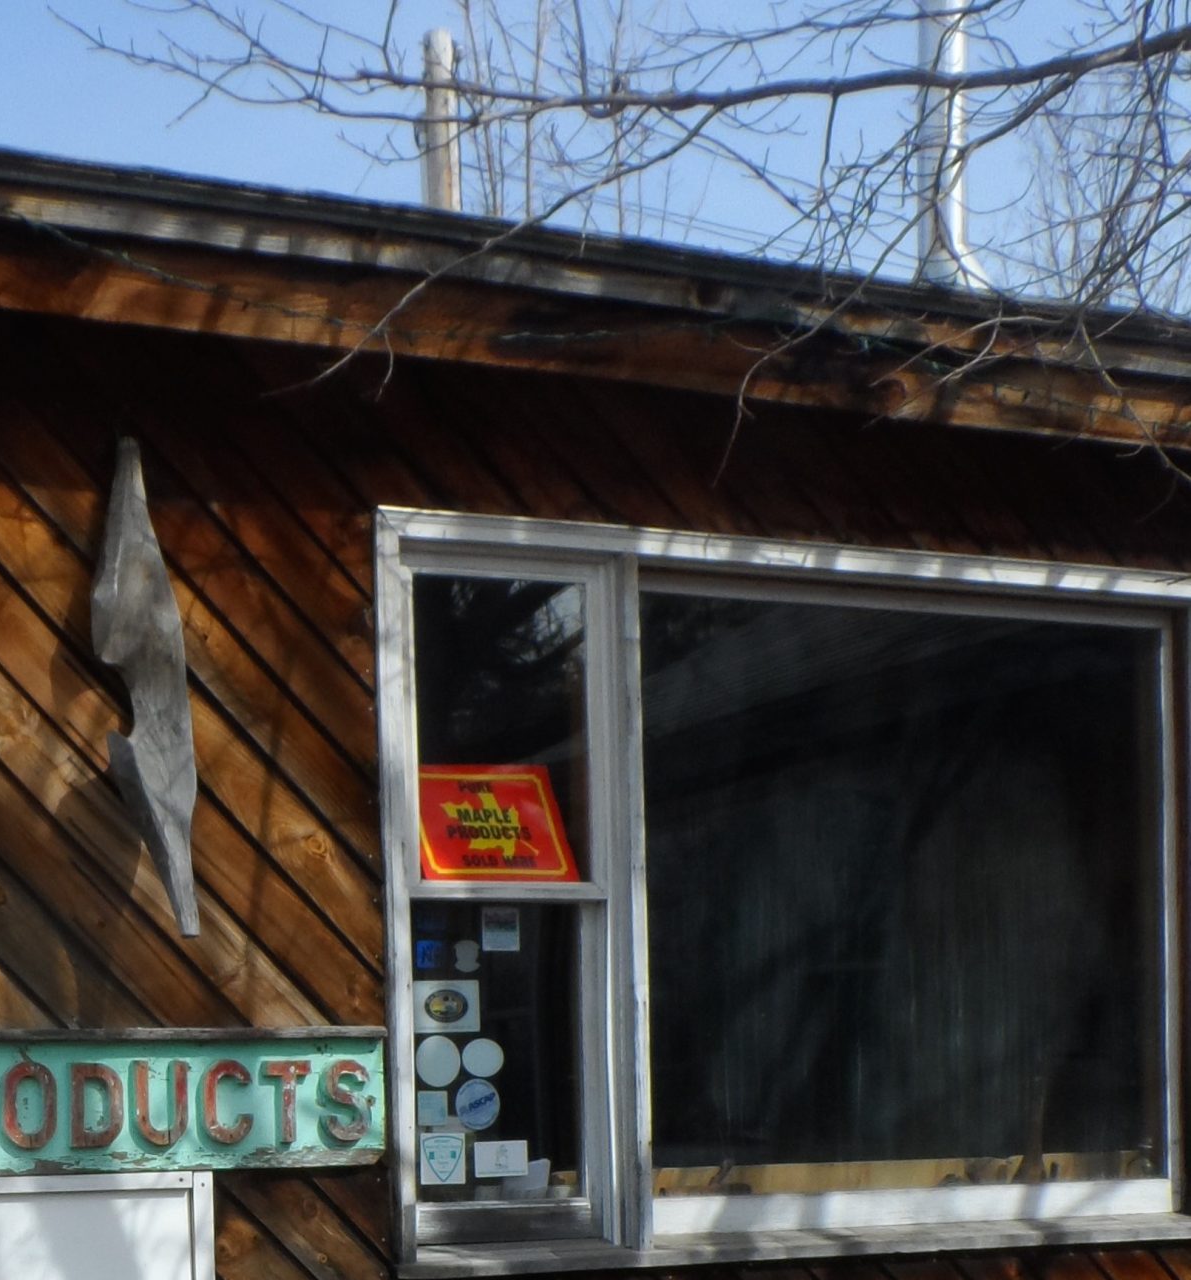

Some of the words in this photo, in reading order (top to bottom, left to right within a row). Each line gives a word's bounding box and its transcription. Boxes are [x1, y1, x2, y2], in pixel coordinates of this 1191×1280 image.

[457, 809, 512, 823] MAPLE
[447, 827, 532, 840] PRODUCTS
[463, 855, 499, 867] SOLD
